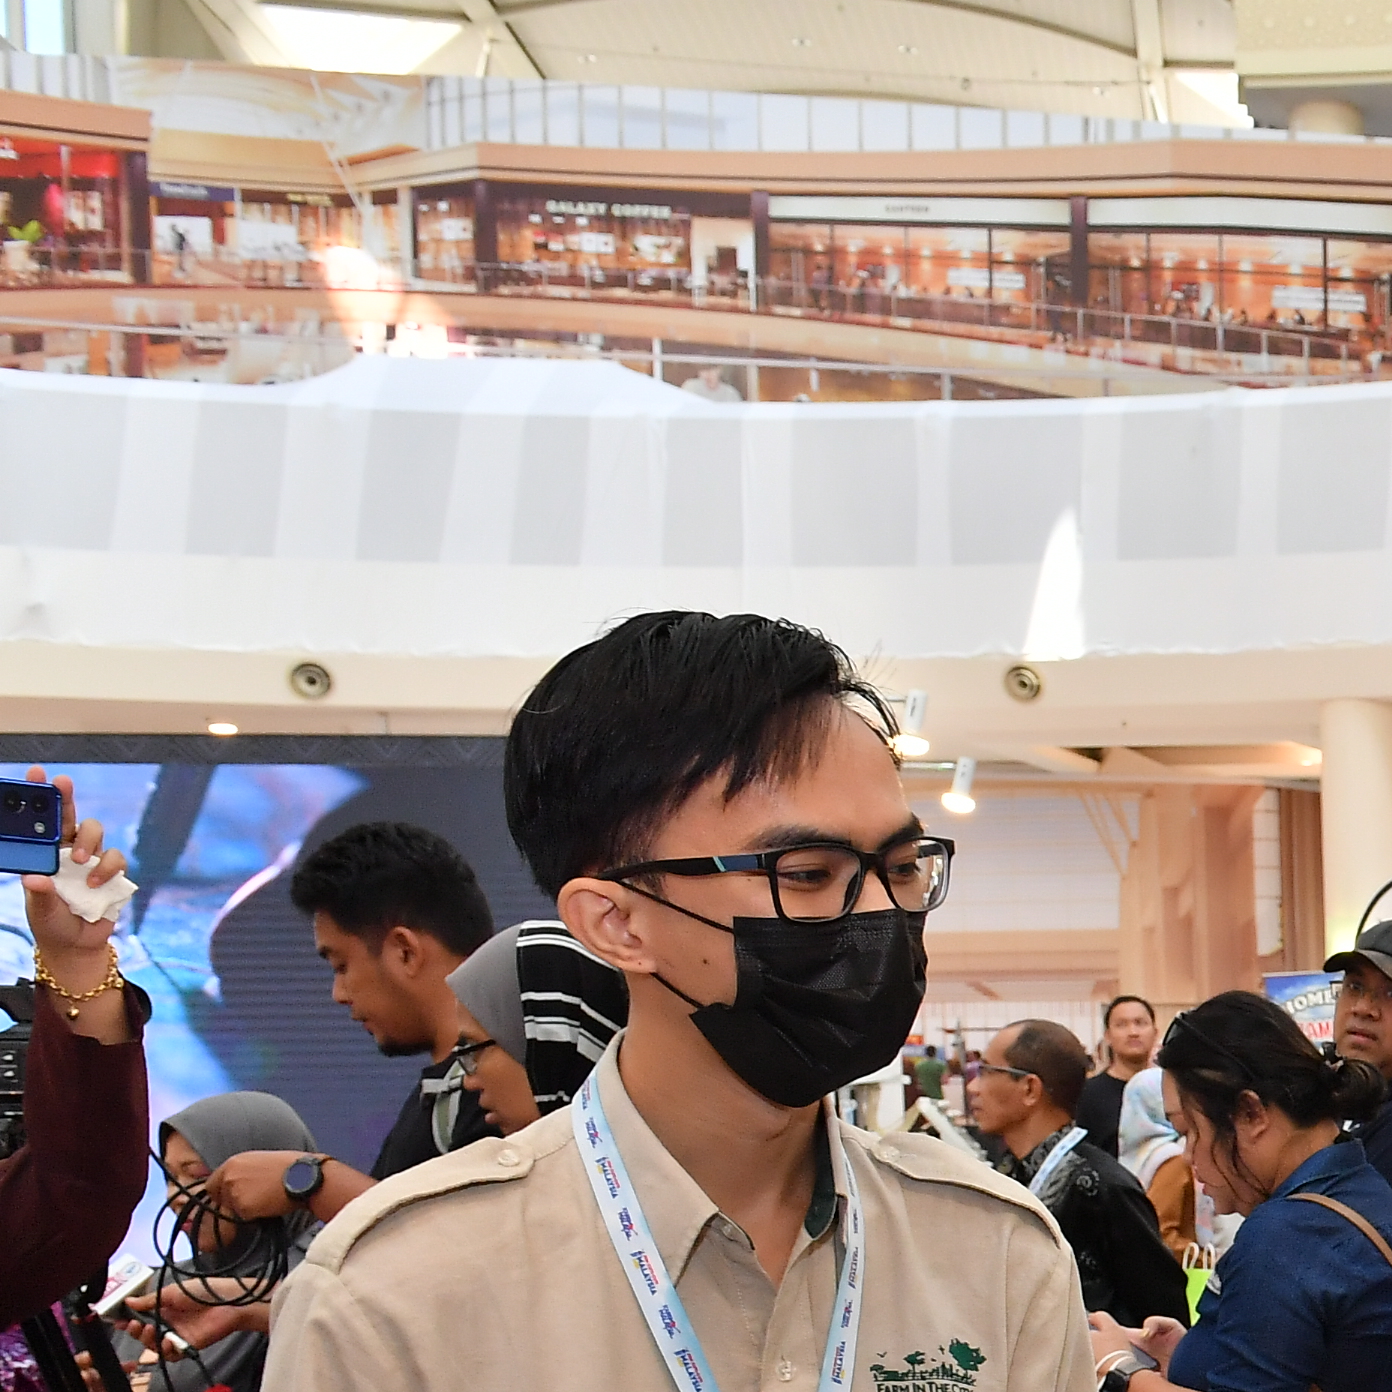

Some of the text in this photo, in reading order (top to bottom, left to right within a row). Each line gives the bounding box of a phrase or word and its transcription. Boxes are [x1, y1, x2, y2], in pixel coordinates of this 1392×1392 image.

[546, 199, 671, 220] GALAXY COFFEE
[602, 1161, 618, 1199] MALAYSIA
[636, 1252, 657, 1296] MALAYSIA
